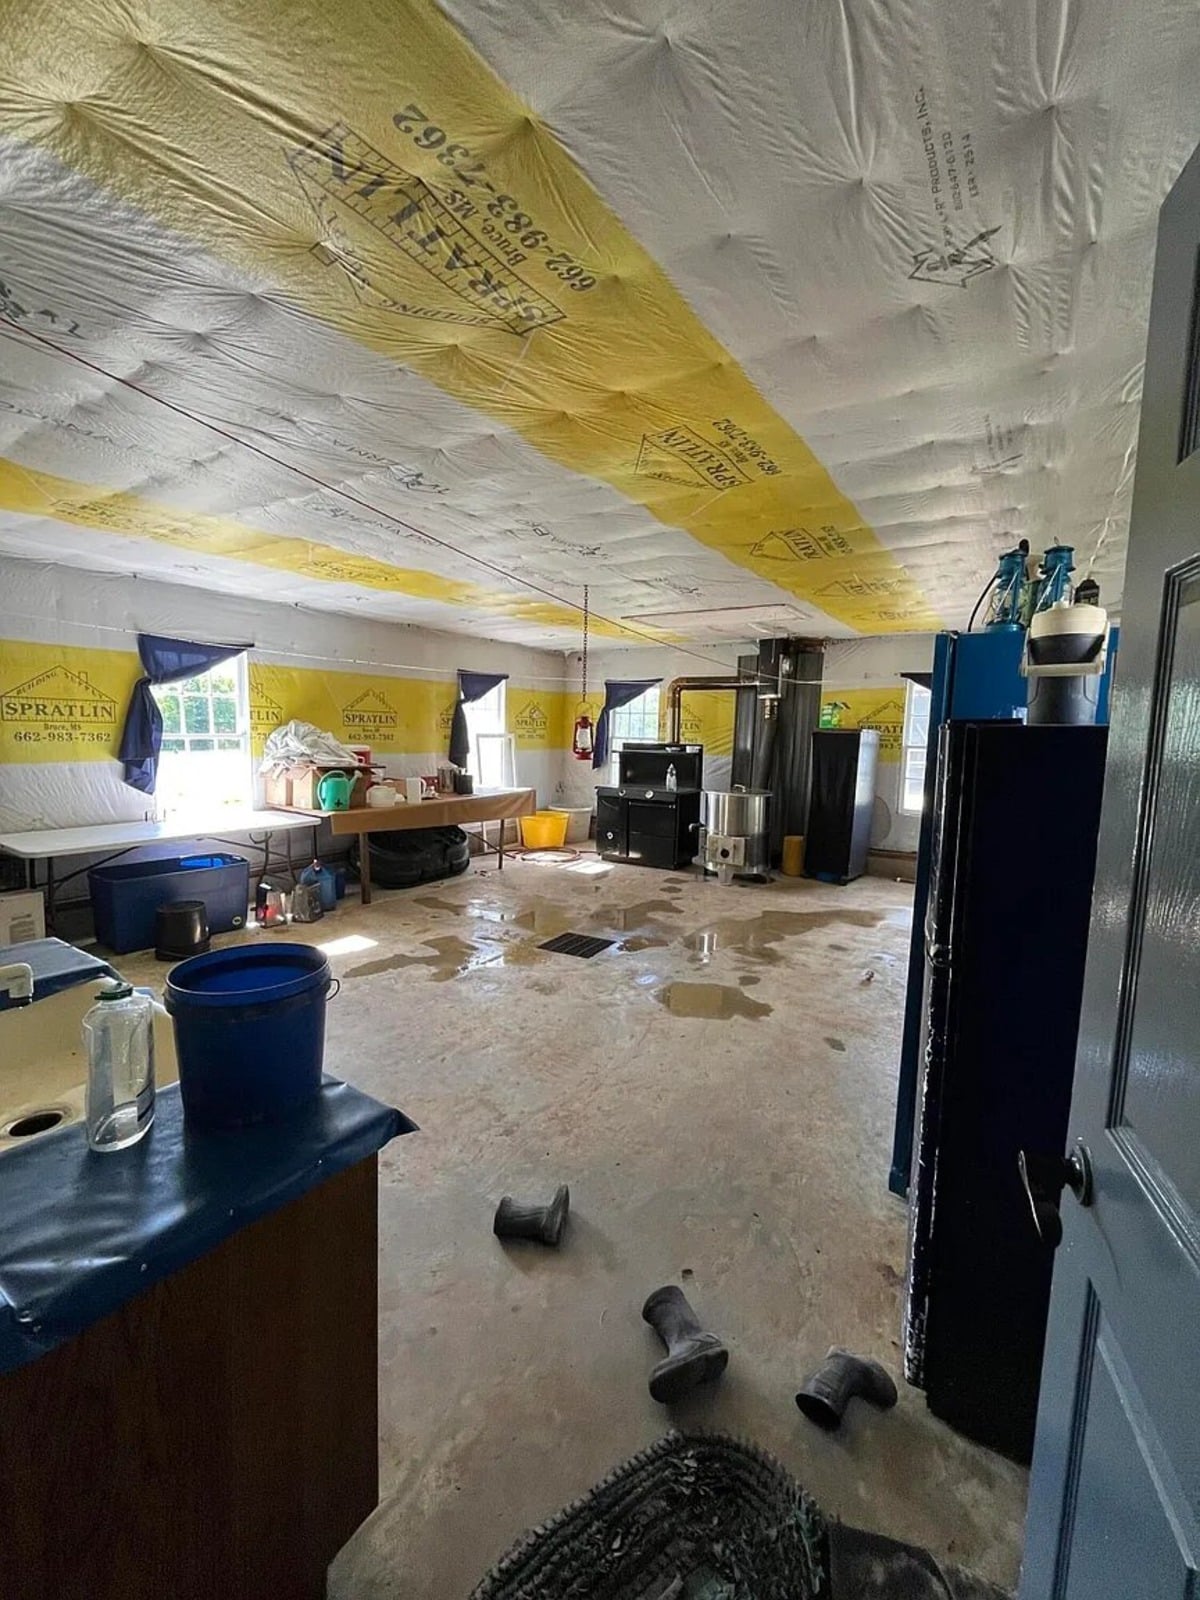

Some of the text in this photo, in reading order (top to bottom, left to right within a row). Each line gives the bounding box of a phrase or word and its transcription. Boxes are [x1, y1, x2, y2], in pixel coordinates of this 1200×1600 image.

[914, 85, 928, 120] INC.
[920, 120, 943, 195] PRODUCTS,
[393, 103, 597, 293] 662-983-7362
[322, 141, 548, 322] SPRATLIN
[444, 188, 528, 267] Bruce, MS
[658, 430, 743, 488] SPRATLIN
[5, 702, 114, 718] SPRATLIN
[250, 710, 280, 721] TLIN
[345, 713, 397, 725] SPRATLIN
[14, 731, 112, 743] 662-983-7362
